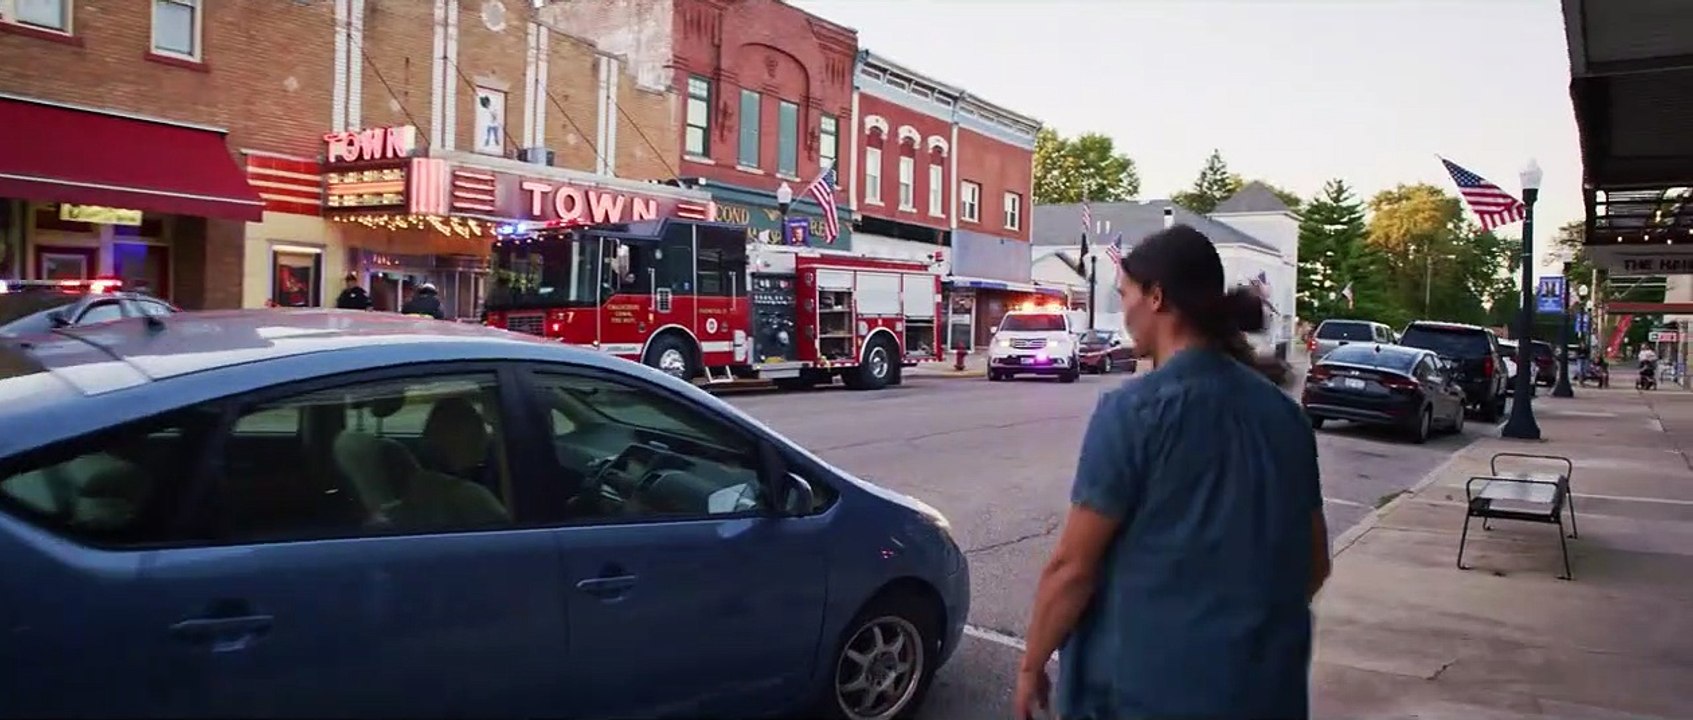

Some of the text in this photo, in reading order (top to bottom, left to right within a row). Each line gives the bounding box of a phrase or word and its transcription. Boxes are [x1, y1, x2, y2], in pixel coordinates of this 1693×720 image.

[323, 126, 414, 163] TOWN
[522, 181, 657, 223] TOWN
[715, 205, 750, 225] COND
